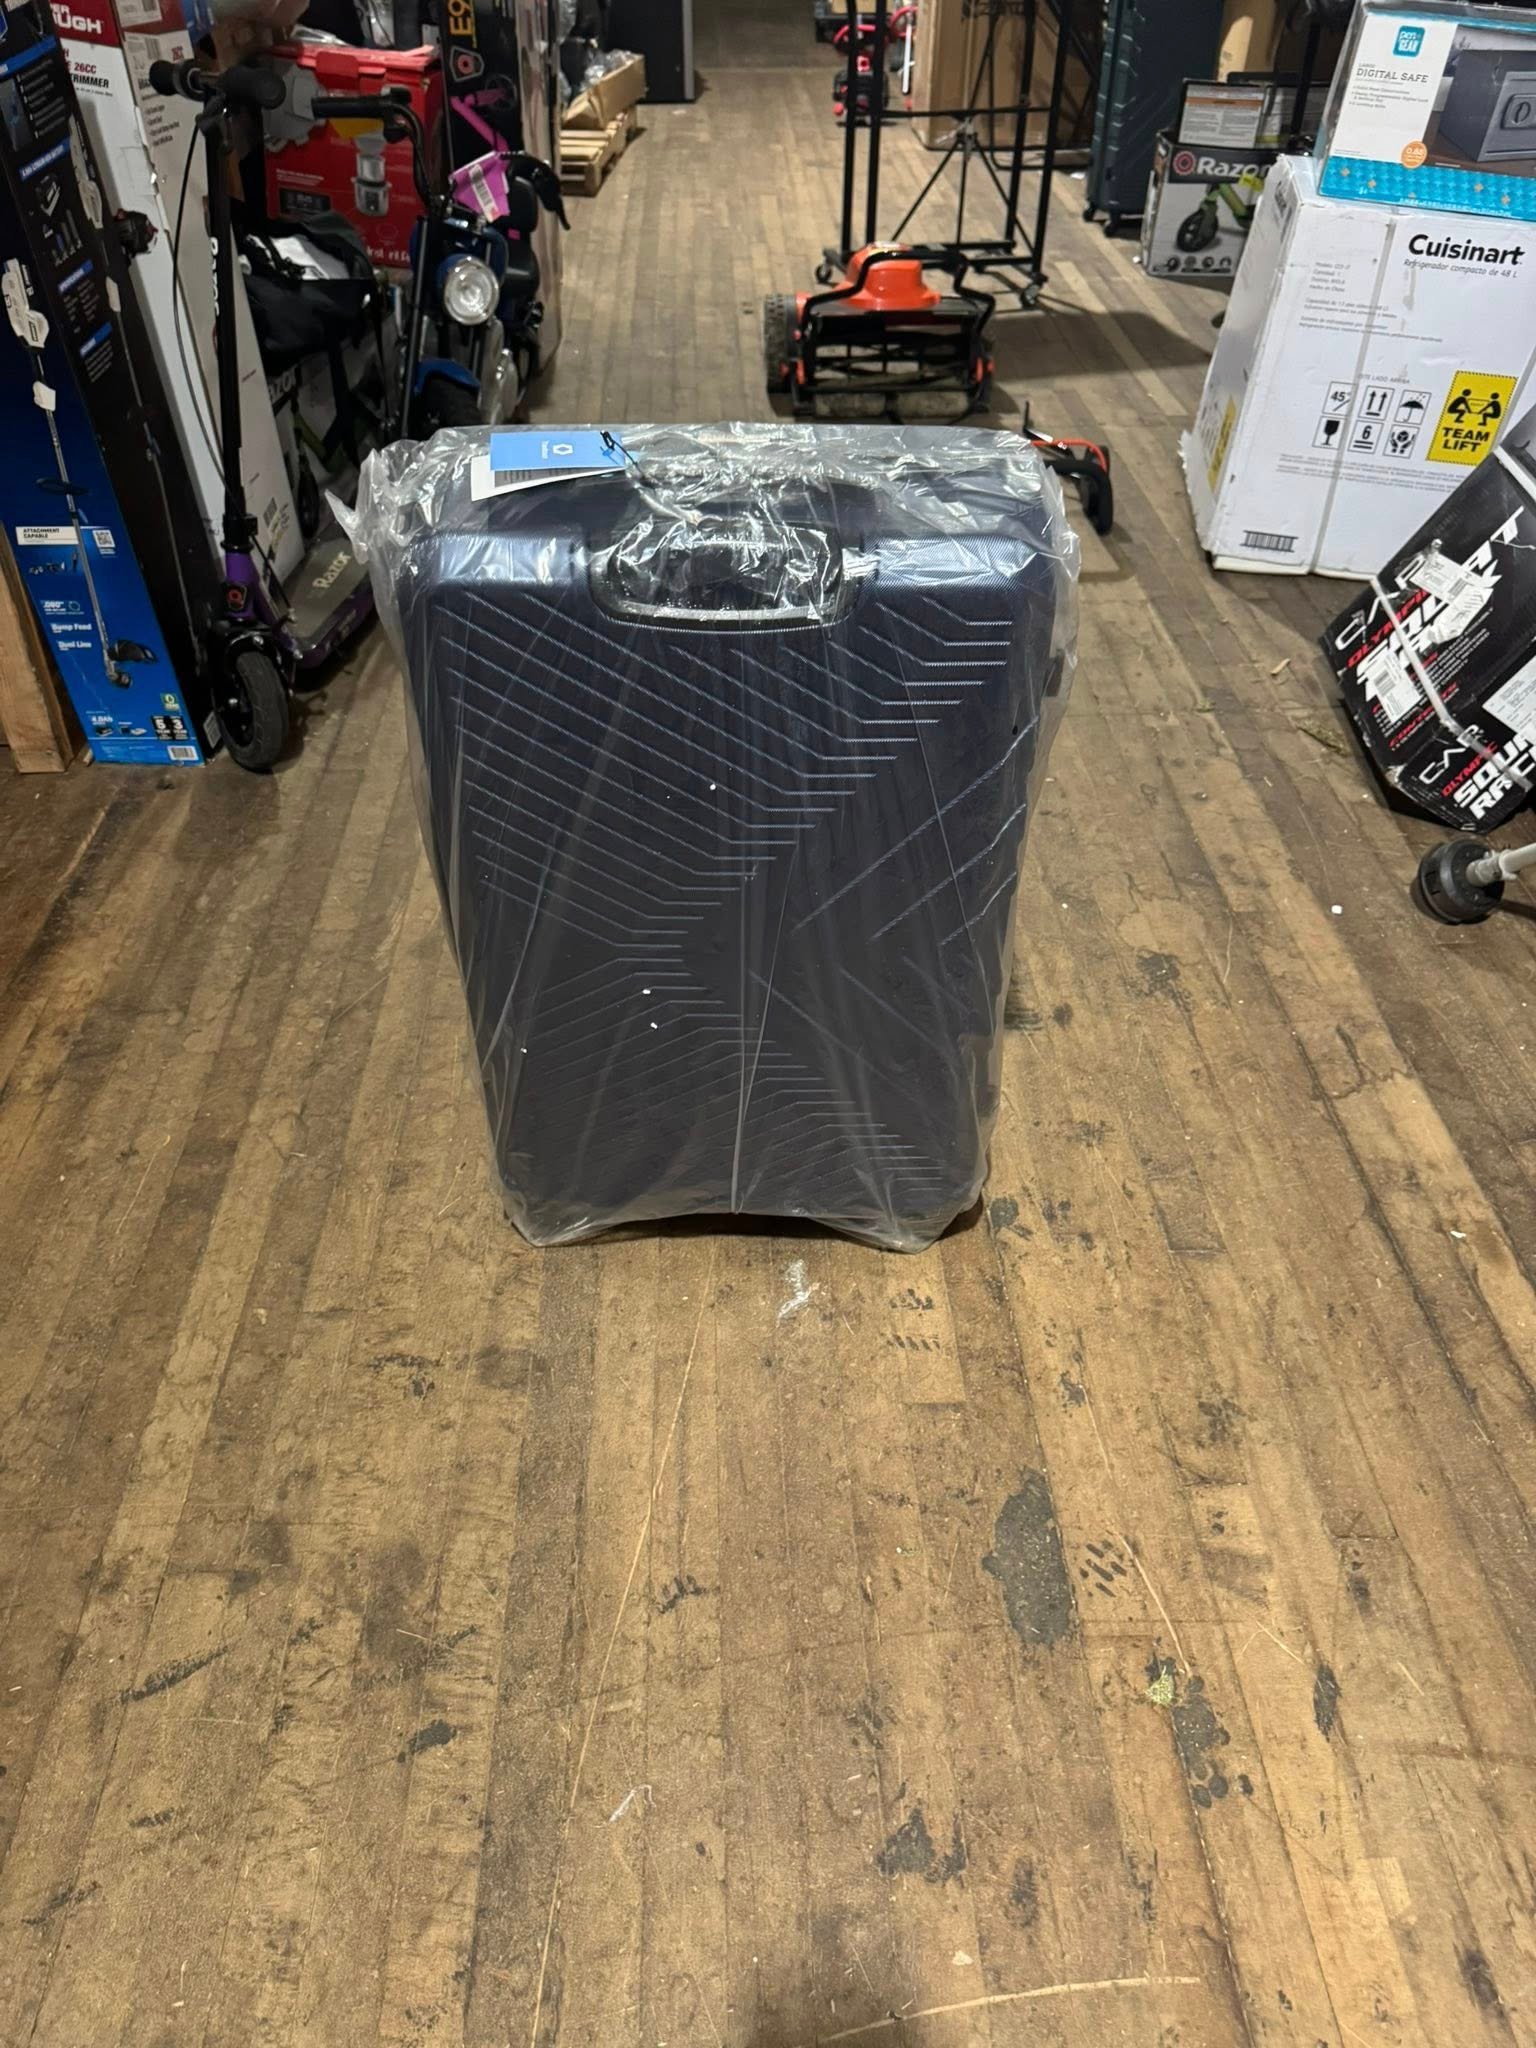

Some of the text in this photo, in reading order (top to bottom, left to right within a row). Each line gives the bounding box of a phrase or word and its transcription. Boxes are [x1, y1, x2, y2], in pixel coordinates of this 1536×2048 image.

[74, 62, 97, 74] 26CC
[1356, 68, 1398, 80] DIGITAL
[1400, 72, 1429, 83] SAFE
[1408, 234, 1525, 265] Cuisinart
[1403, 259, 1449, 270] Refrigerador
[1450, 265, 1487, 275] compacto
[1488, 268, 1498, 276] de
[1500, 269, 1511, 278] 48
[1362, 425, 1373, 440] 6
[1442, 427, 1490, 442] TEAM
[1442, 438, 1481, 452] LIFT
[311, 551, 352, 589] Razor
[155, 718, 183, 730] 5 3
[1453, 733, 1530, 808] SQUA
